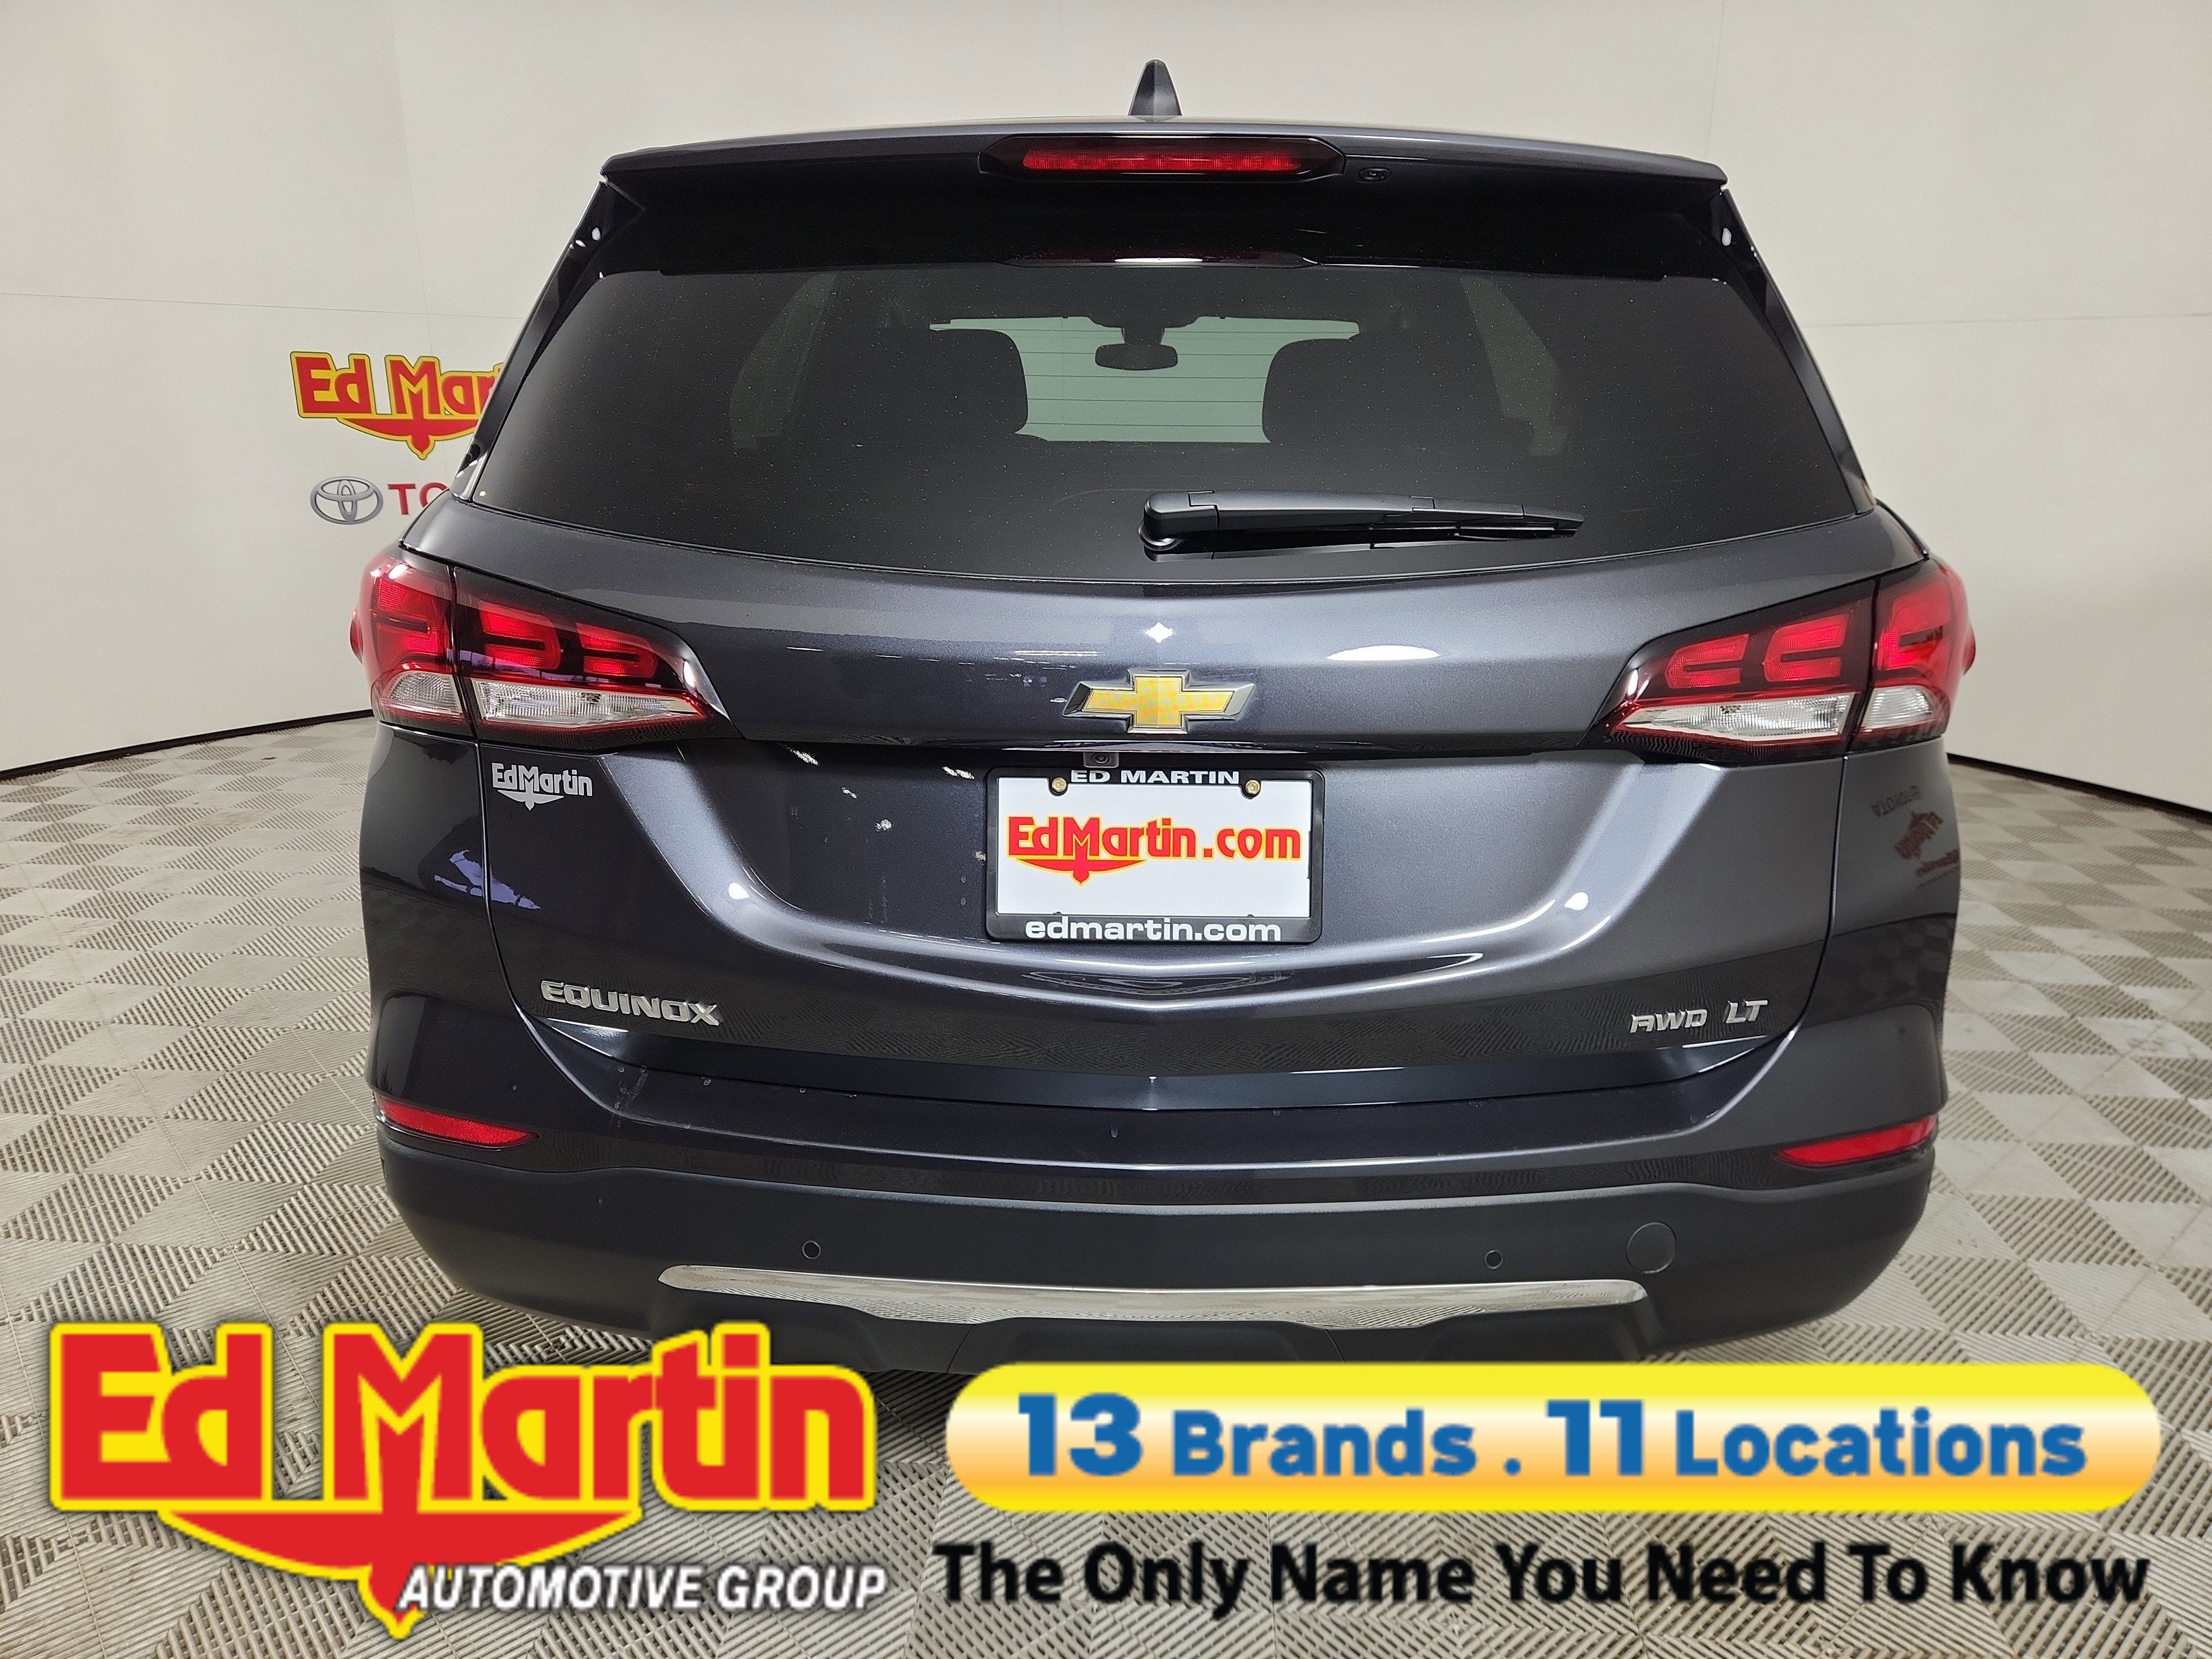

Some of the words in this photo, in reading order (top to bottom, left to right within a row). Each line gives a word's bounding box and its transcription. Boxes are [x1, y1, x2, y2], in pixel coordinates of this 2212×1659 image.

[294, 355, 373, 415] Ed
[388, 358, 500, 416] Mar
[1070, 770, 1110, 784] ED
[1120, 770, 1239, 785] MARTIN
[1007, 816, 1301, 859] EdMartin.com
[1025, 916, 1281, 942] edmartin.com
[541, 980, 720, 1026] EQUINOX
[1629, 1008, 1708, 1034] AWD
[1725, 999, 1769, 1024] LT
